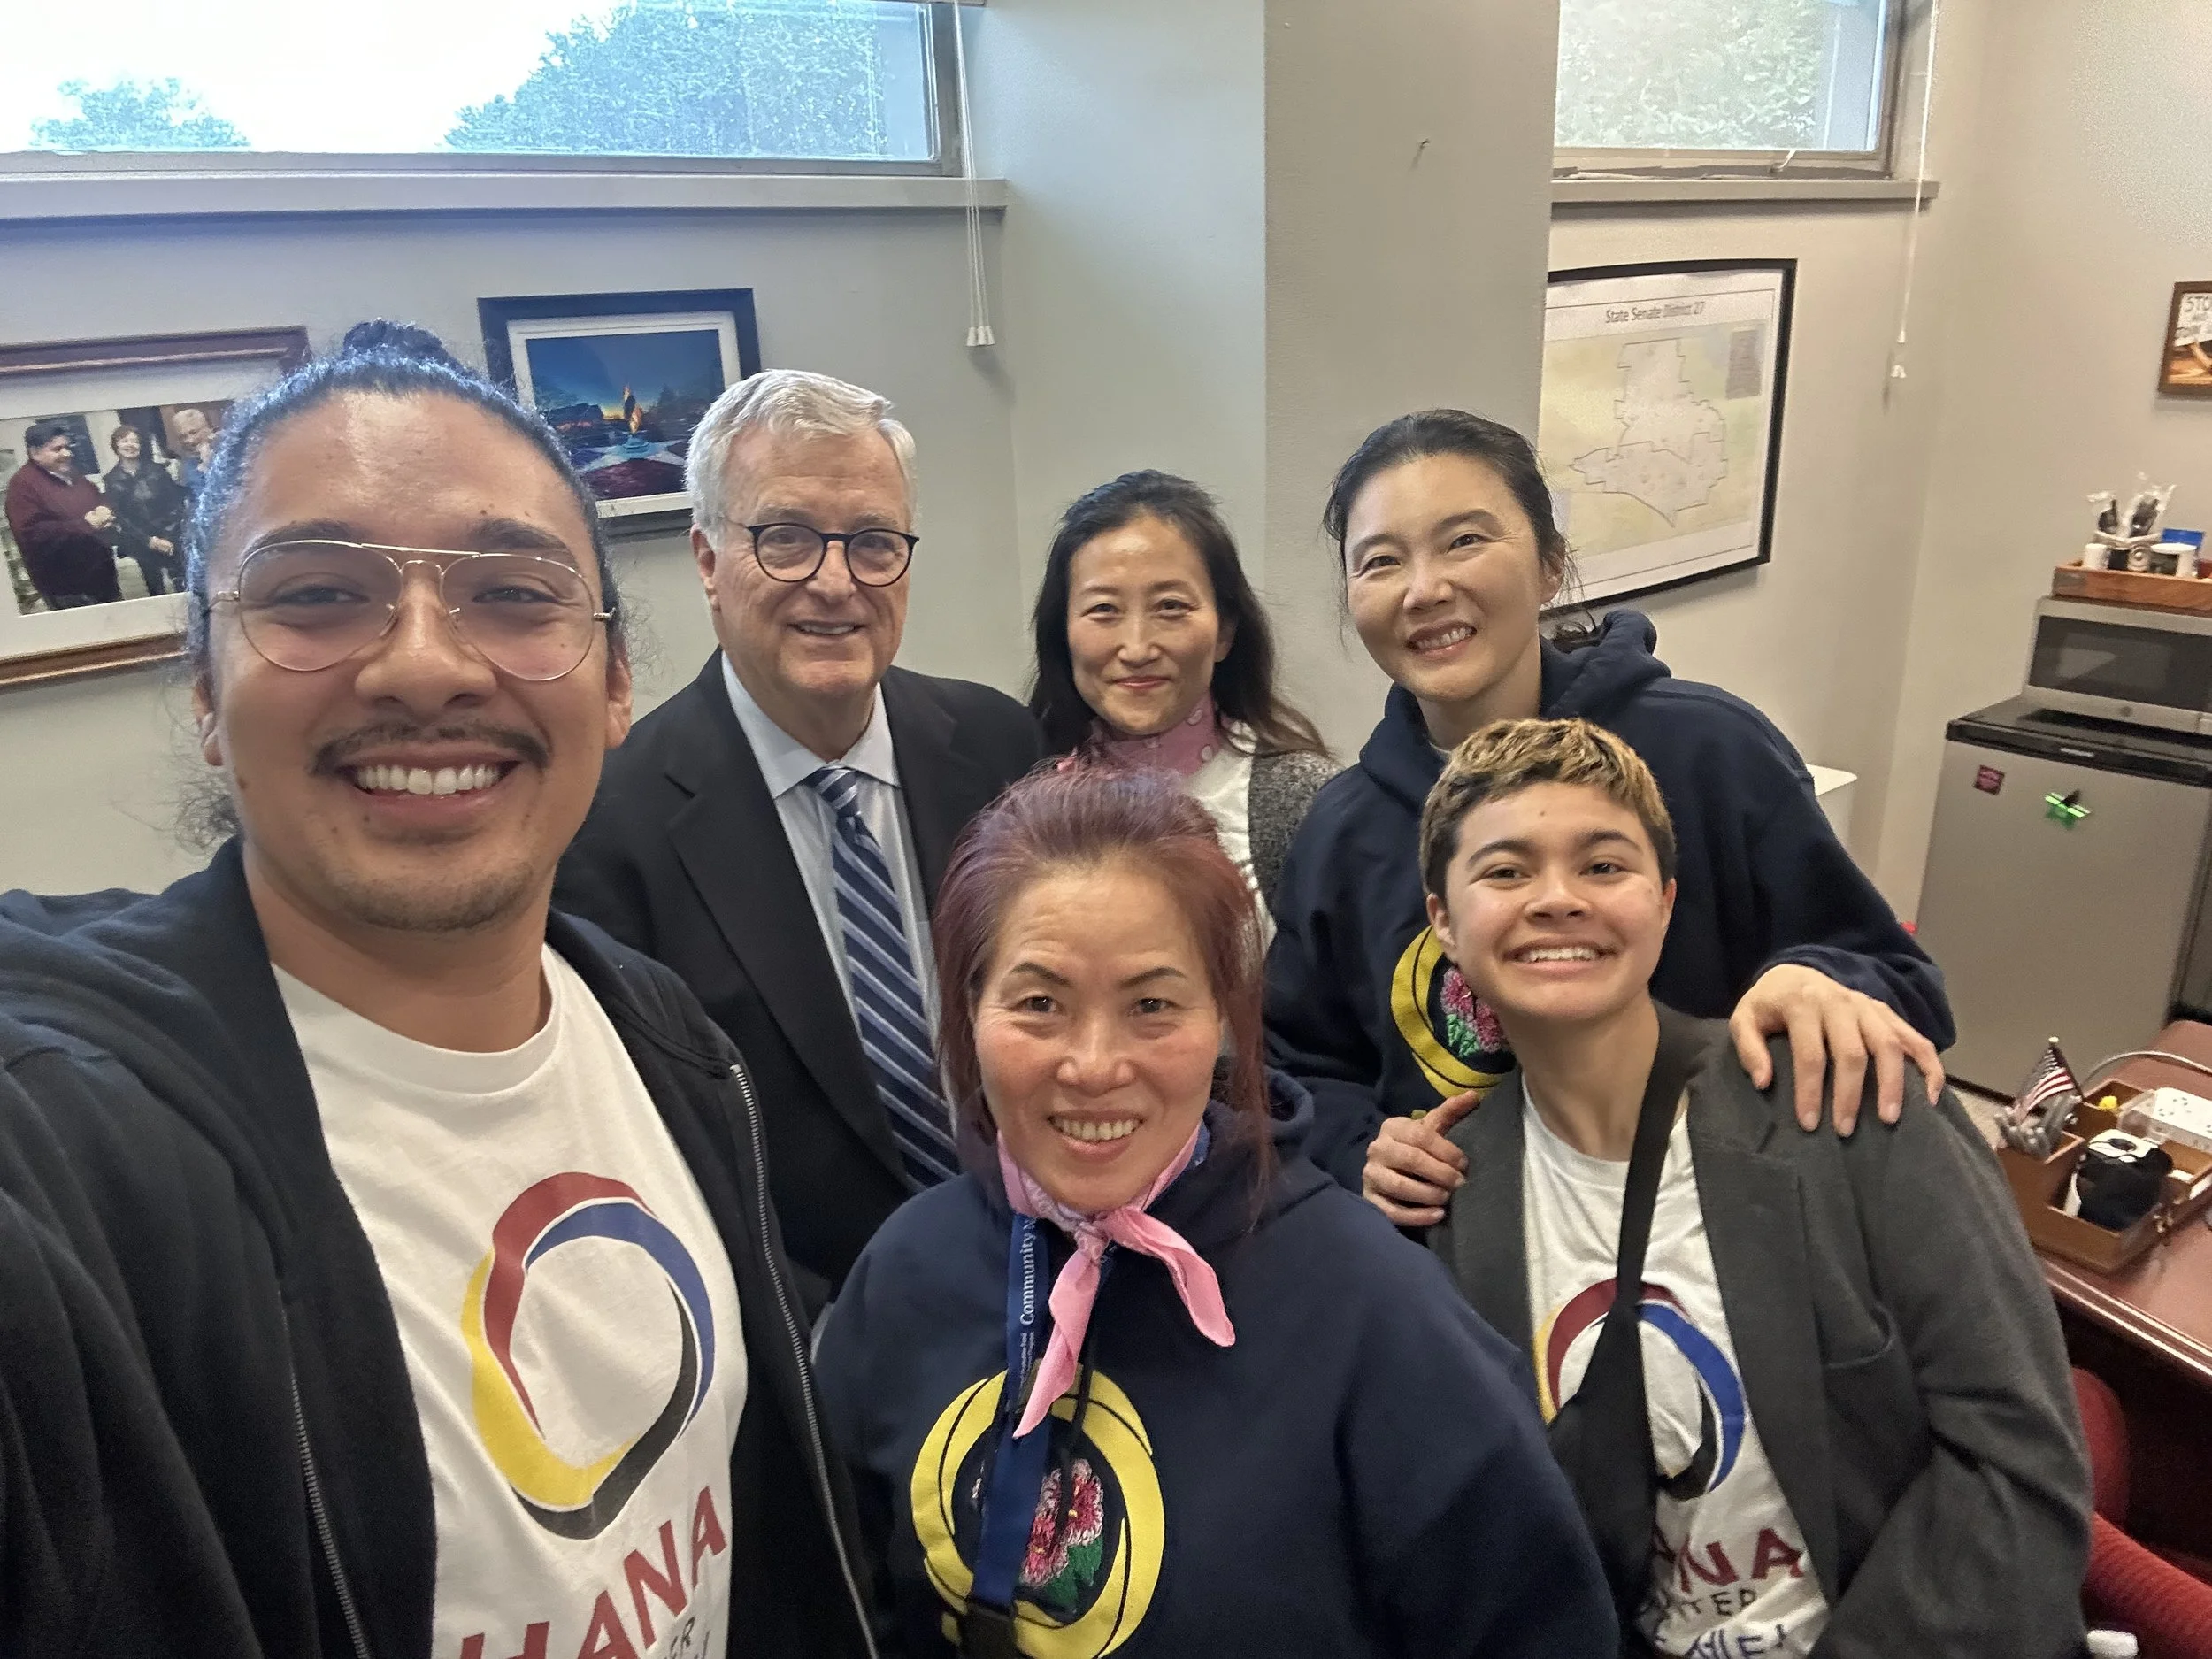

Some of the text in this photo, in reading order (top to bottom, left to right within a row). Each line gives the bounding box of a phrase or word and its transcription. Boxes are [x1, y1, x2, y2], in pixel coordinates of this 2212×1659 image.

[1605, 309, 1629, 324] State
[1631, 306, 1662, 321] Senate
[1019, 1233, 1036, 1325] Community
